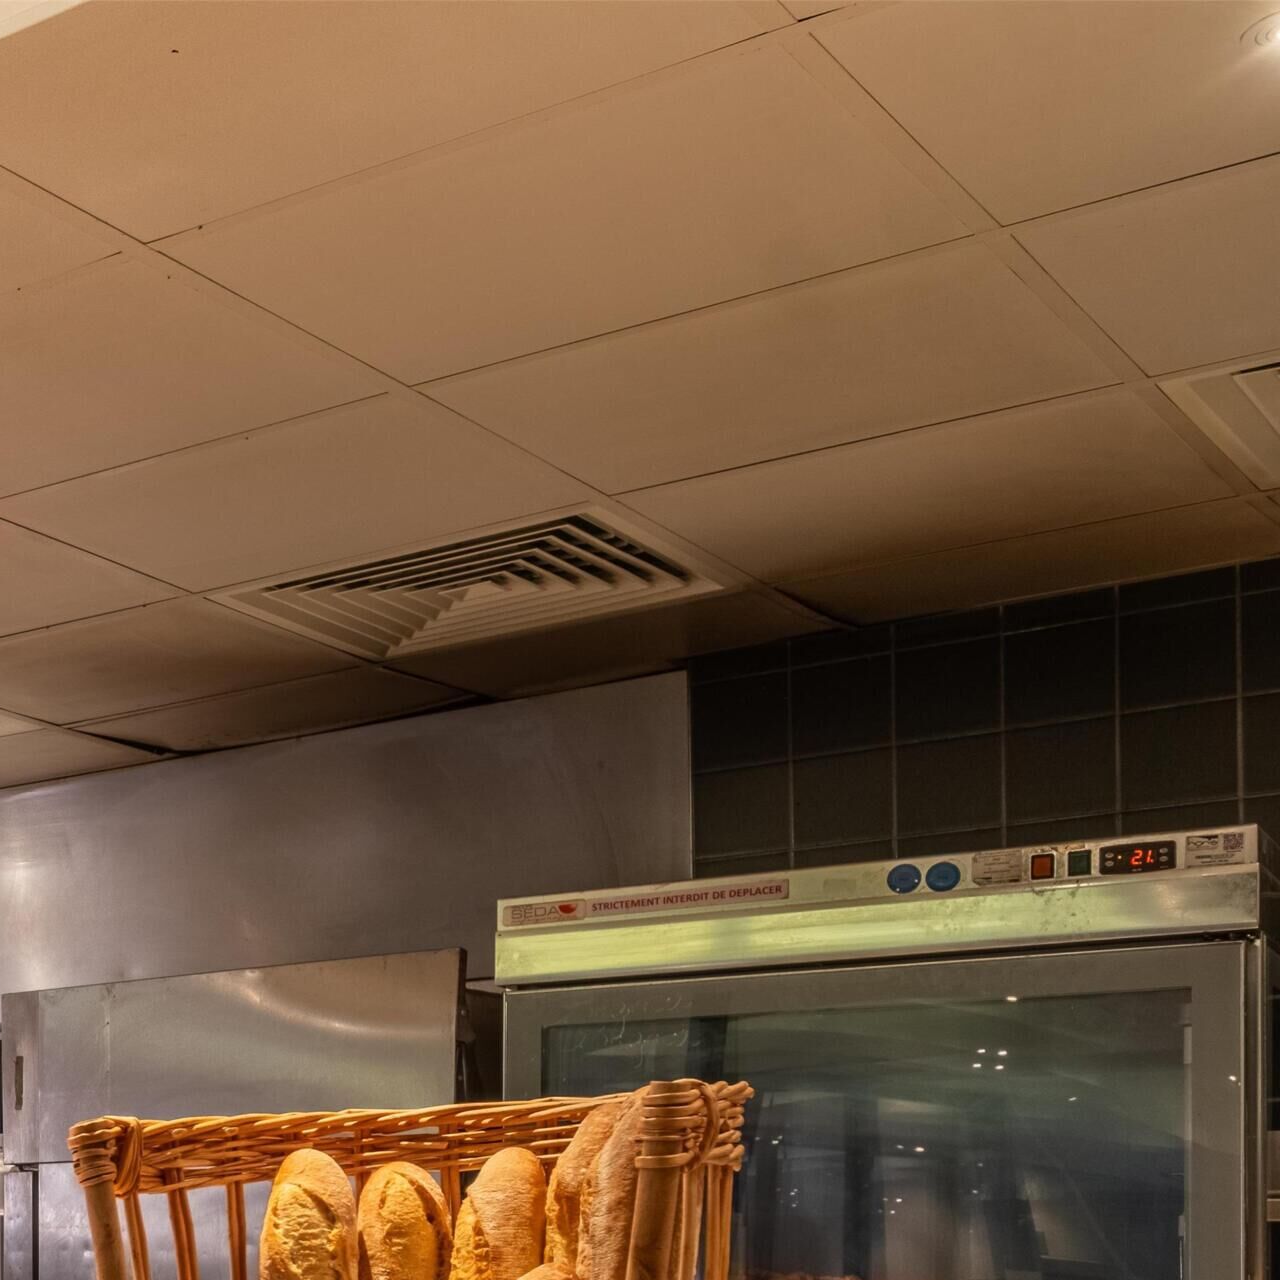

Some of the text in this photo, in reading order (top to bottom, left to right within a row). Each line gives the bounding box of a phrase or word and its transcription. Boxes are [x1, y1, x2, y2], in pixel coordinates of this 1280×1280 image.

[592, 885, 783, 912] STRICTEMENT INTERDIT DE DEPLACER
[511, 905, 559, 920] SEDA
